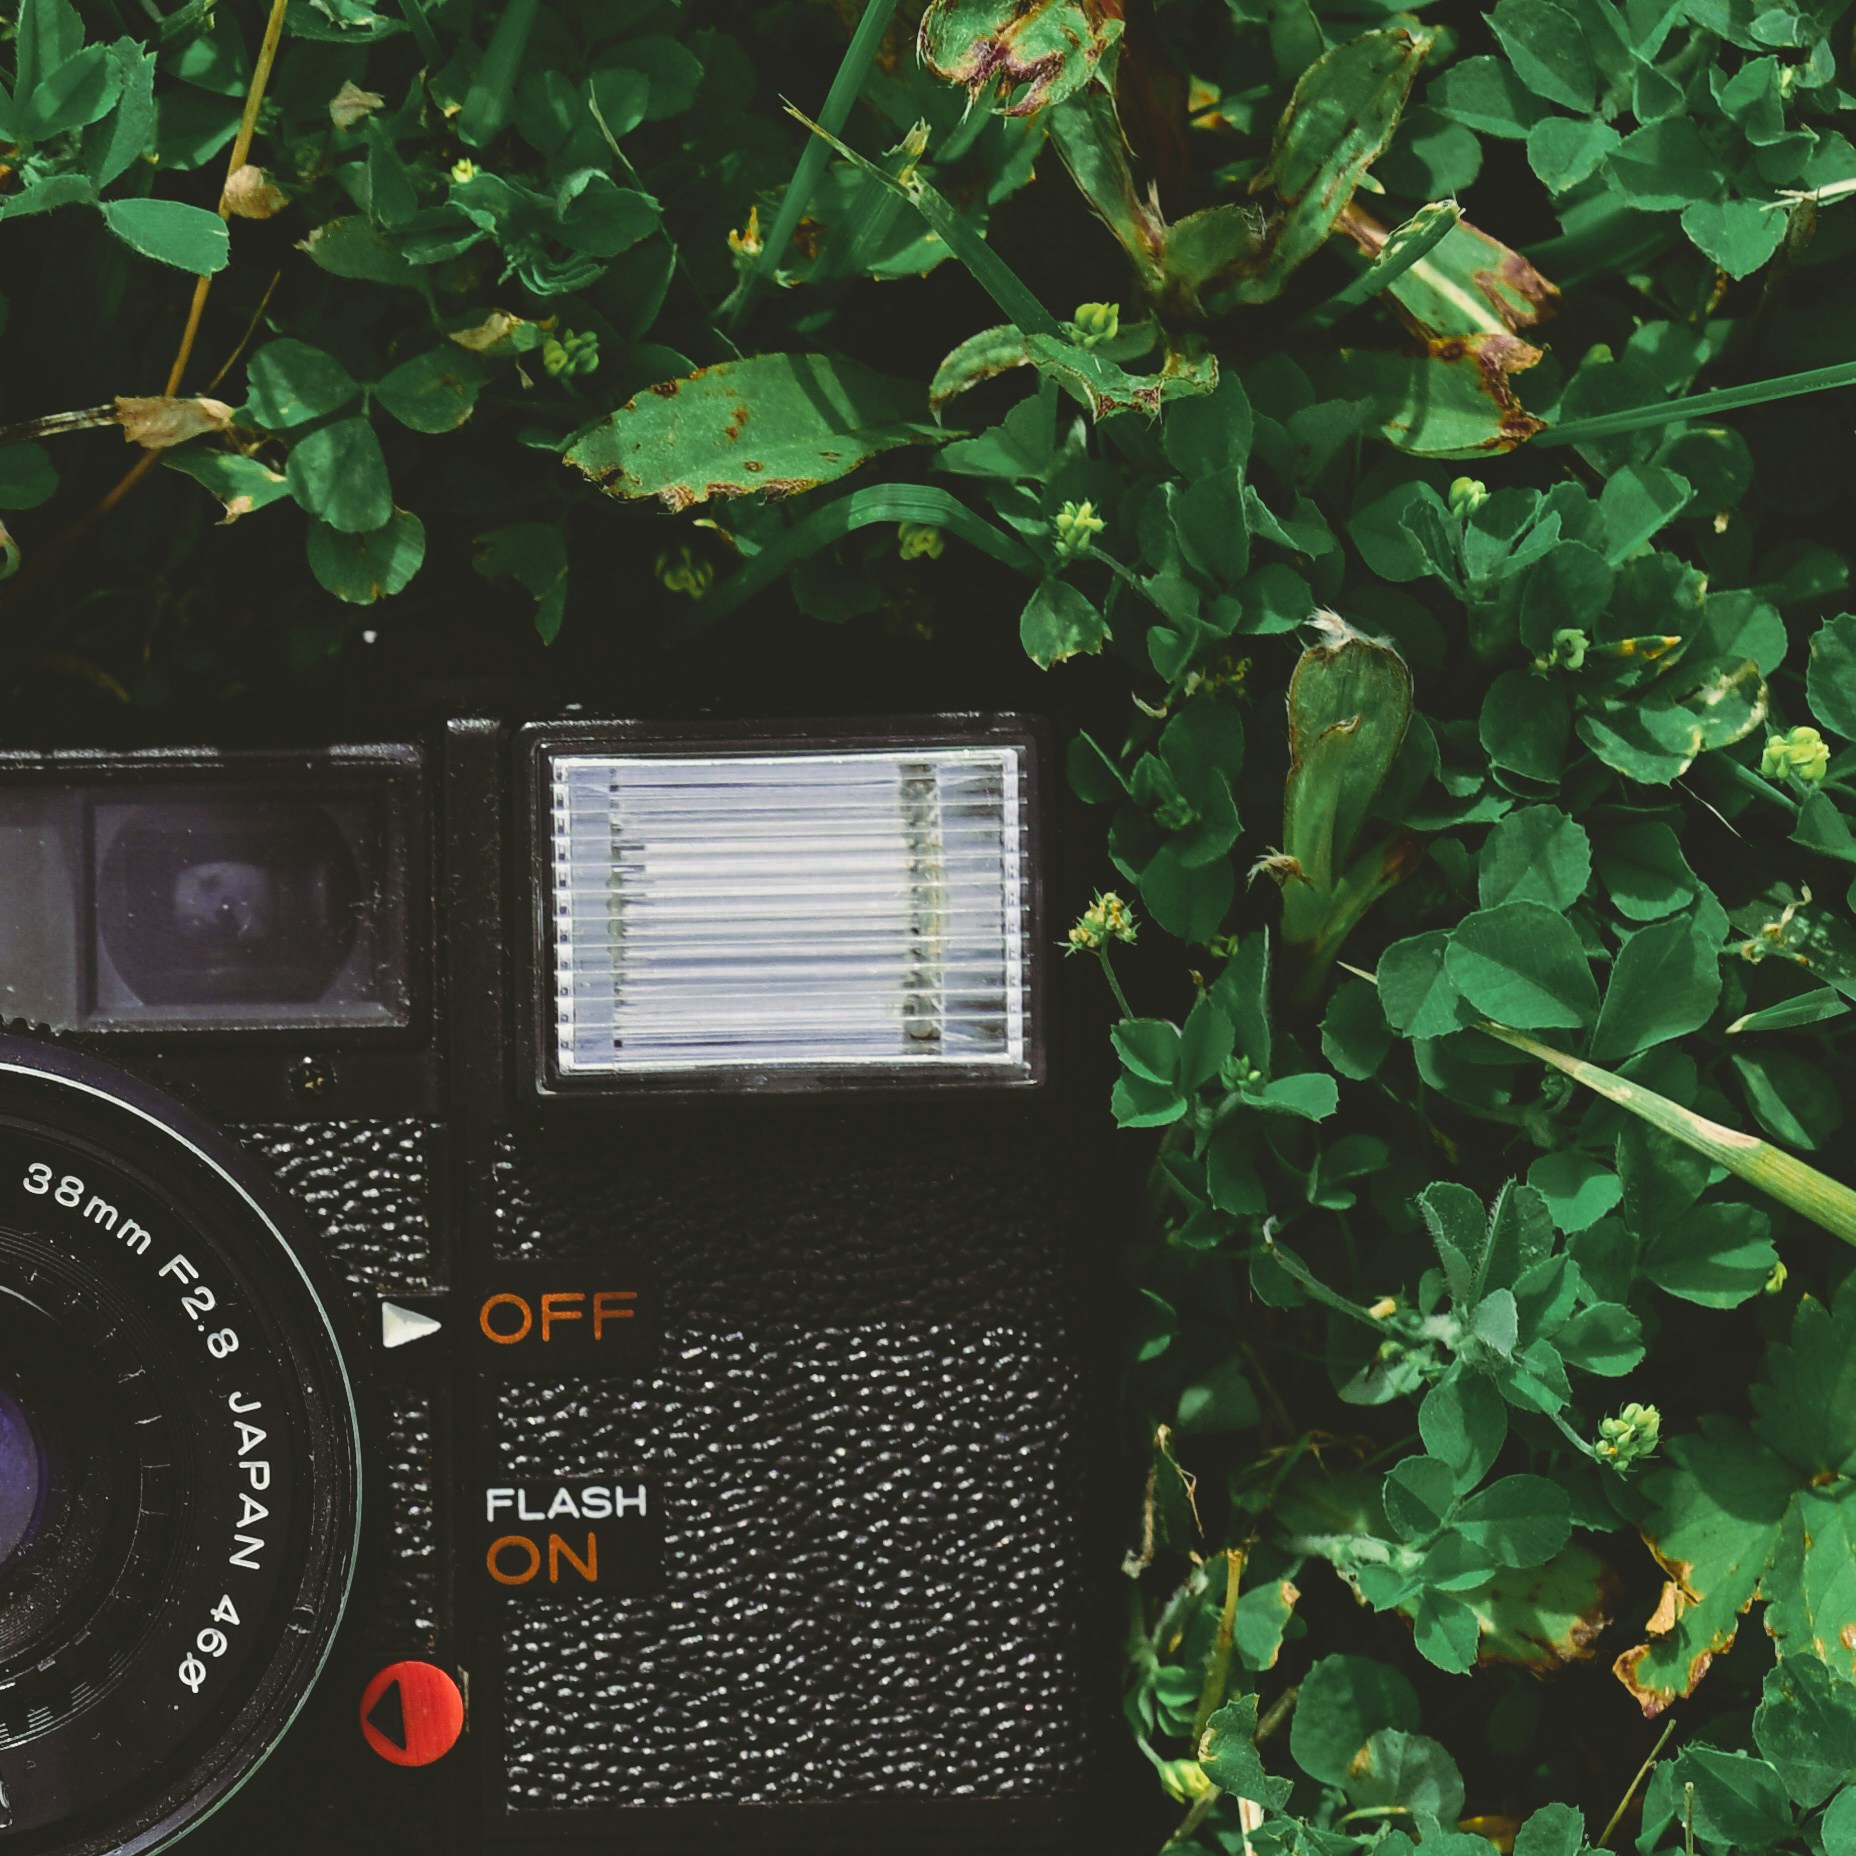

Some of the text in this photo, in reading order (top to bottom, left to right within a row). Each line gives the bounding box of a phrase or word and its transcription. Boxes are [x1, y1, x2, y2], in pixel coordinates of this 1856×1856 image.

[480, 1292, 638, 1344] OFF
[22, 1162, 153, 1255] 38mm
[158, 1254, 240, 1359] F2.8
[227, 1391, 270, 1571] JAPAN
[486, 1485, 647, 1522] FLASH
[486, 1532, 598, 1585] ON
